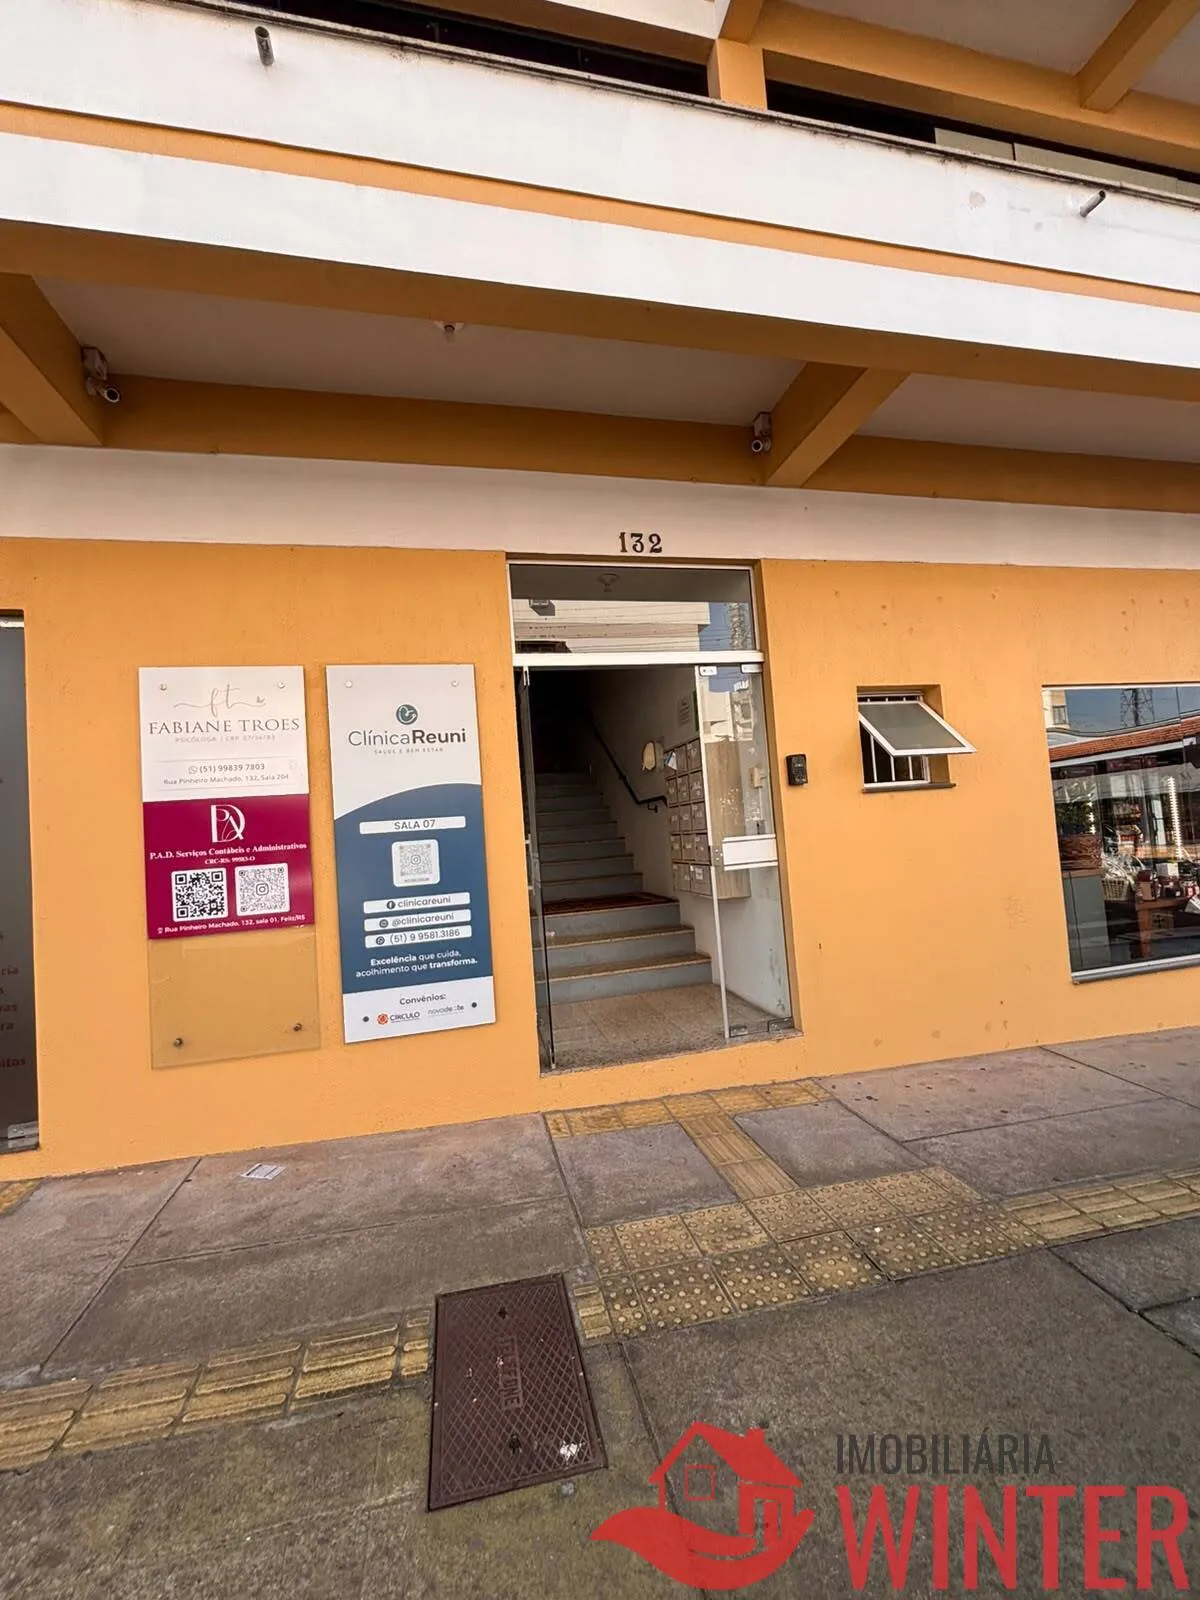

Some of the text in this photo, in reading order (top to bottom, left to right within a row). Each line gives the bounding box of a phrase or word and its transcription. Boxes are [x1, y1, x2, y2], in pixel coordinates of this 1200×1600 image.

[619, 531, 662, 553] 132
[149, 718, 300, 735] FABIANE TROES
[199, 765, 216, 774] (51)
[218, 764, 243, 772] 99839
[179, 777, 207, 785] Pinheiro
[394, 819, 436, 830] SALA 07
[150, 850, 175, 860] P.A.D.
[176, 847, 207, 858] Serviços
[208, 845, 245, 856] Contábeis
[252, 842, 307, 853] Administrativos
[164, 926, 178, 934] Rua
[180, 924, 207, 932] Pinheiro
[389, 928, 461, 945] (51) 9 9581.3186
[370, 953, 417, 967] Excelência
[418, 953, 435, 963] que
[356, 957, 478, 978] acolhimento que transforma.
[400, 993, 447, 1006] Convênios:
